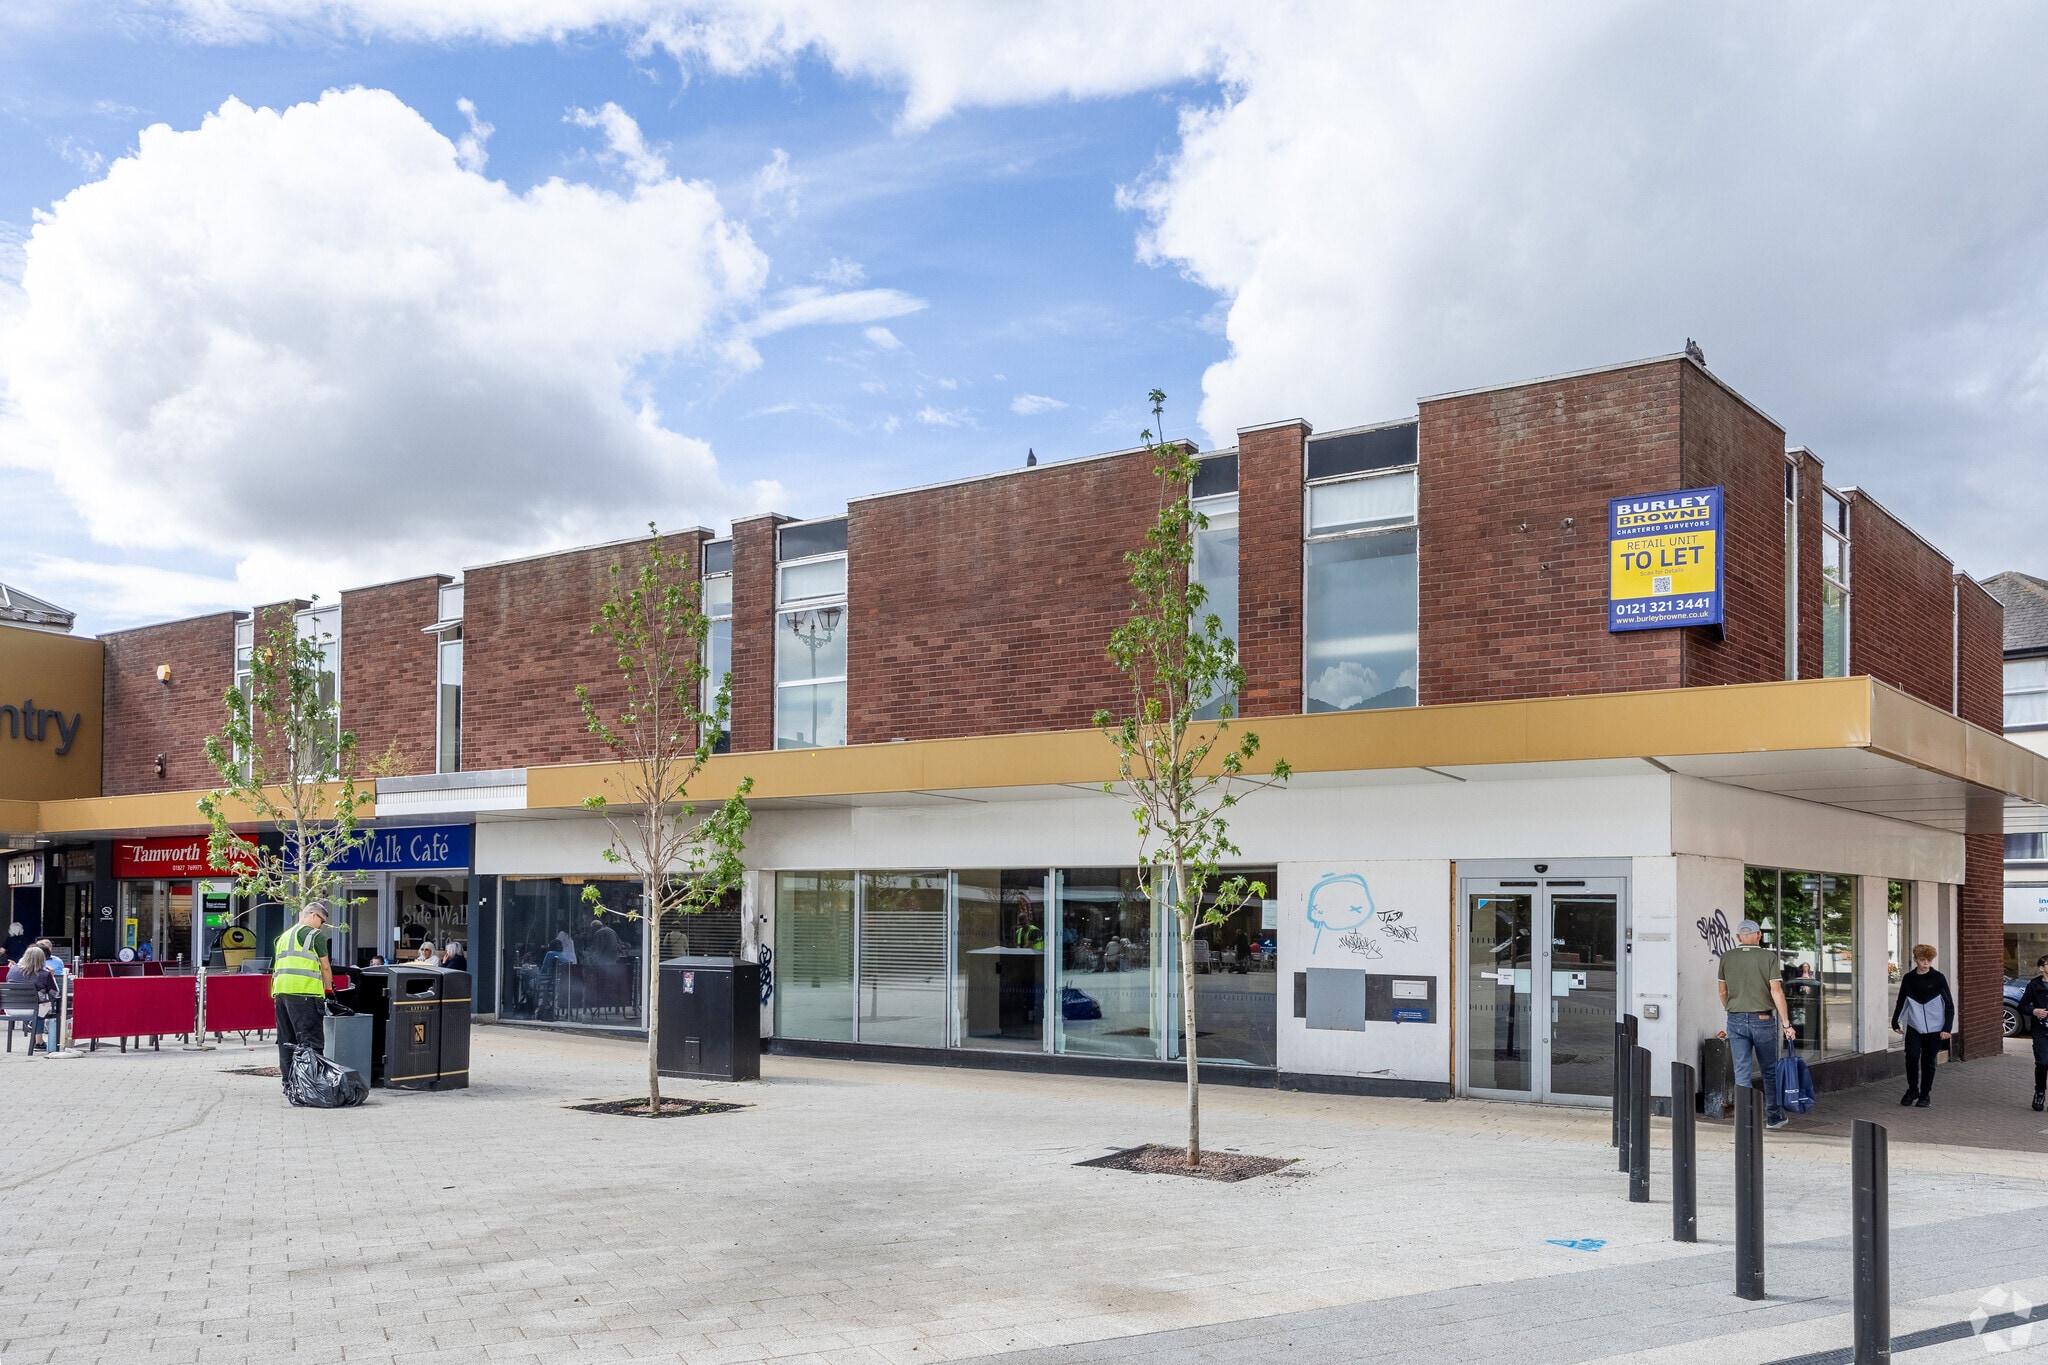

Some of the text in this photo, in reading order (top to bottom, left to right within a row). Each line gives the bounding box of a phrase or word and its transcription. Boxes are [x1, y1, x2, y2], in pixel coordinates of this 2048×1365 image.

[1617, 495, 1711, 515] BURLEY
[1619, 508, 1707, 526] BROWNE
[1617, 521, 1710, 536] CHARTERED SURVEYORS
[1627, 535, 1698, 551] RETAIL UNIT
[1620, 546, 1705, 571] TO LET
[1664, 567, 1684, 575] Details
[1616, 597, 1710, 615] 0121 321 3441
[1616, 611, 1709, 624] www.burleybrowne.co.uk
[132, 843, 200, 862] Tamworth
[357, 834, 402, 863] Walk
[410, 832, 449, 862] Café
[403, 903, 432, 925] Side
